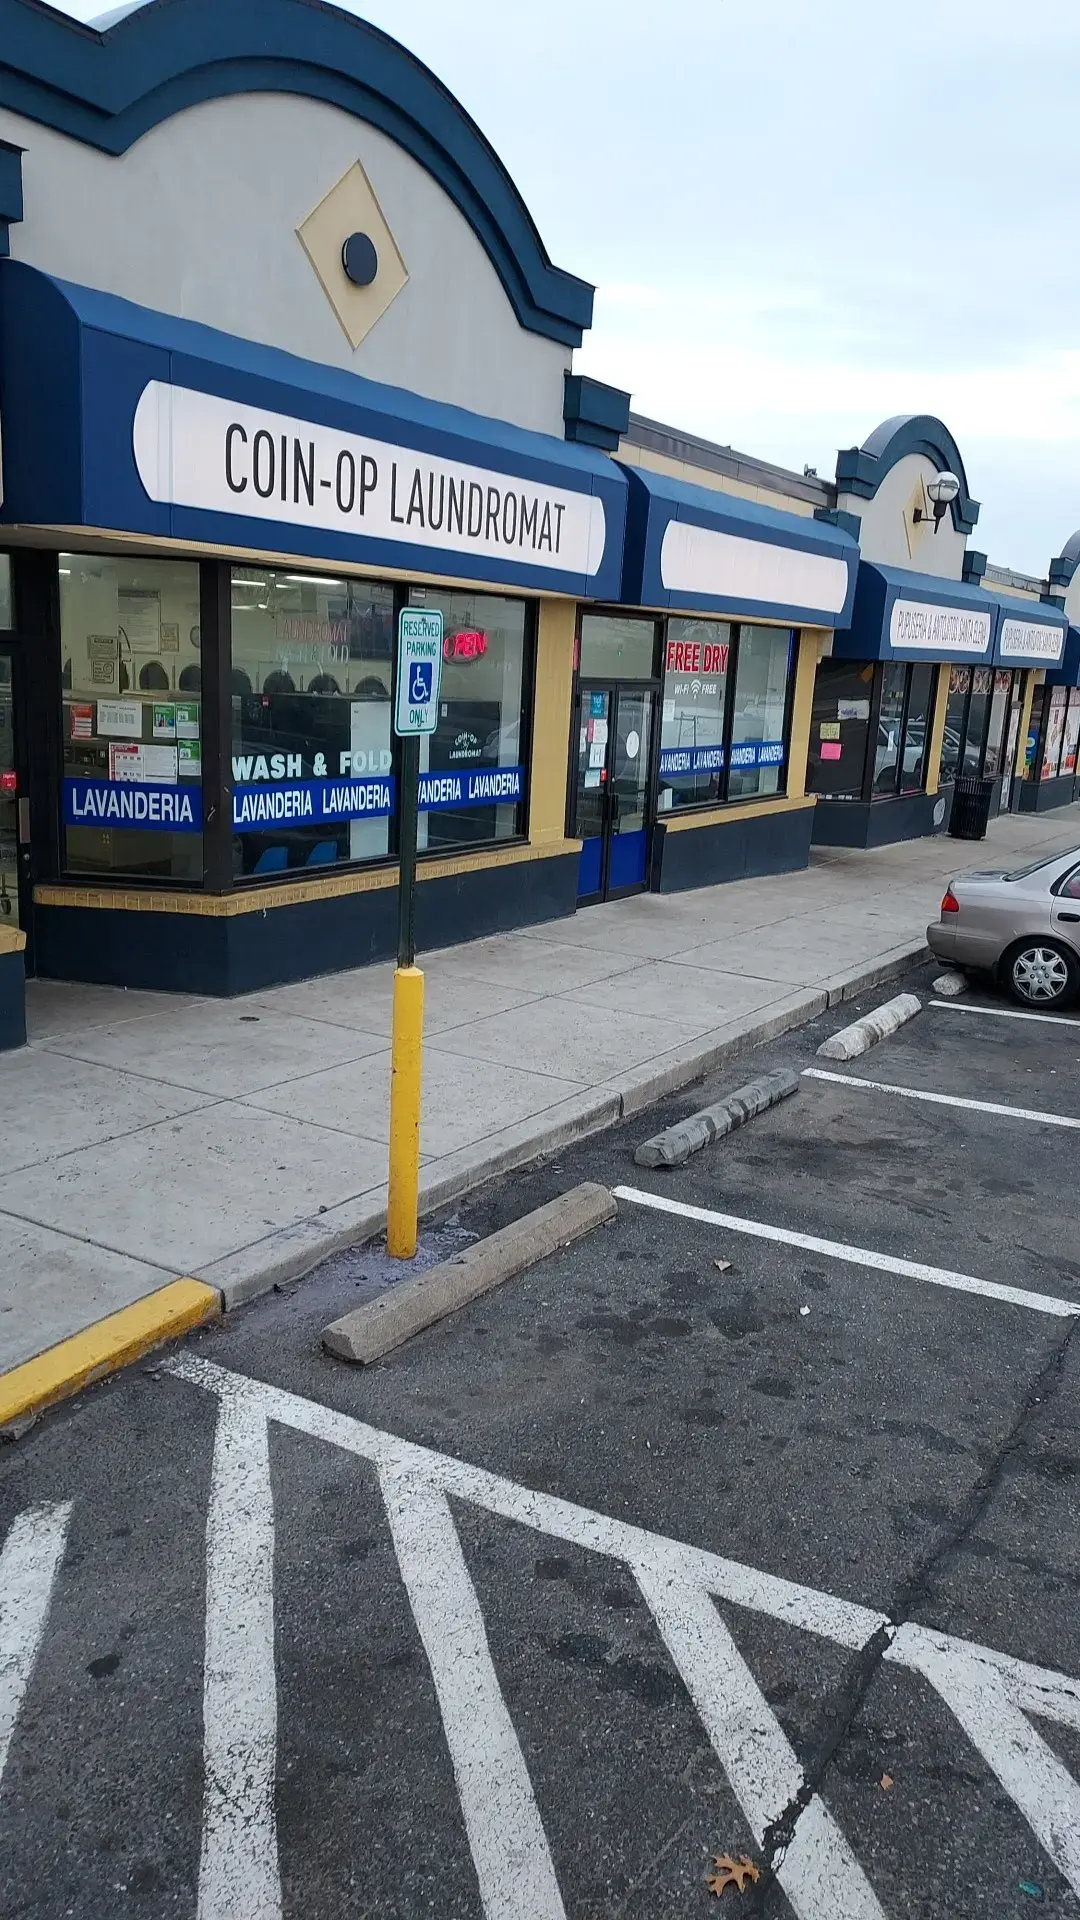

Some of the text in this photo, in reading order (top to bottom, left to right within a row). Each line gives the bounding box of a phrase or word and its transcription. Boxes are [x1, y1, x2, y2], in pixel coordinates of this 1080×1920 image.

[224, 423, 566, 554] COIN-OP LAUNDROMAT
[403, 620, 439, 637] RESERVED
[406, 641, 437, 657] PARKING
[443, 631, 487, 658] OPEN
[666, 640, 729, 675] FREE DRY
[701, 683, 717, 695] FREE
[409, 709, 429, 724] ONLY
[232, 750, 393, 781] WASH & FOLD
[449, 749, 482, 759] LAUNDROMAT
[660, 752, 691, 773] AVANDERIA
[468, 772, 520, 799] LAVANDERIA
[72, 787, 194, 823] LAVANDERIA
[233, 784, 391, 823] LAVANDERIA LAVANDERIA
